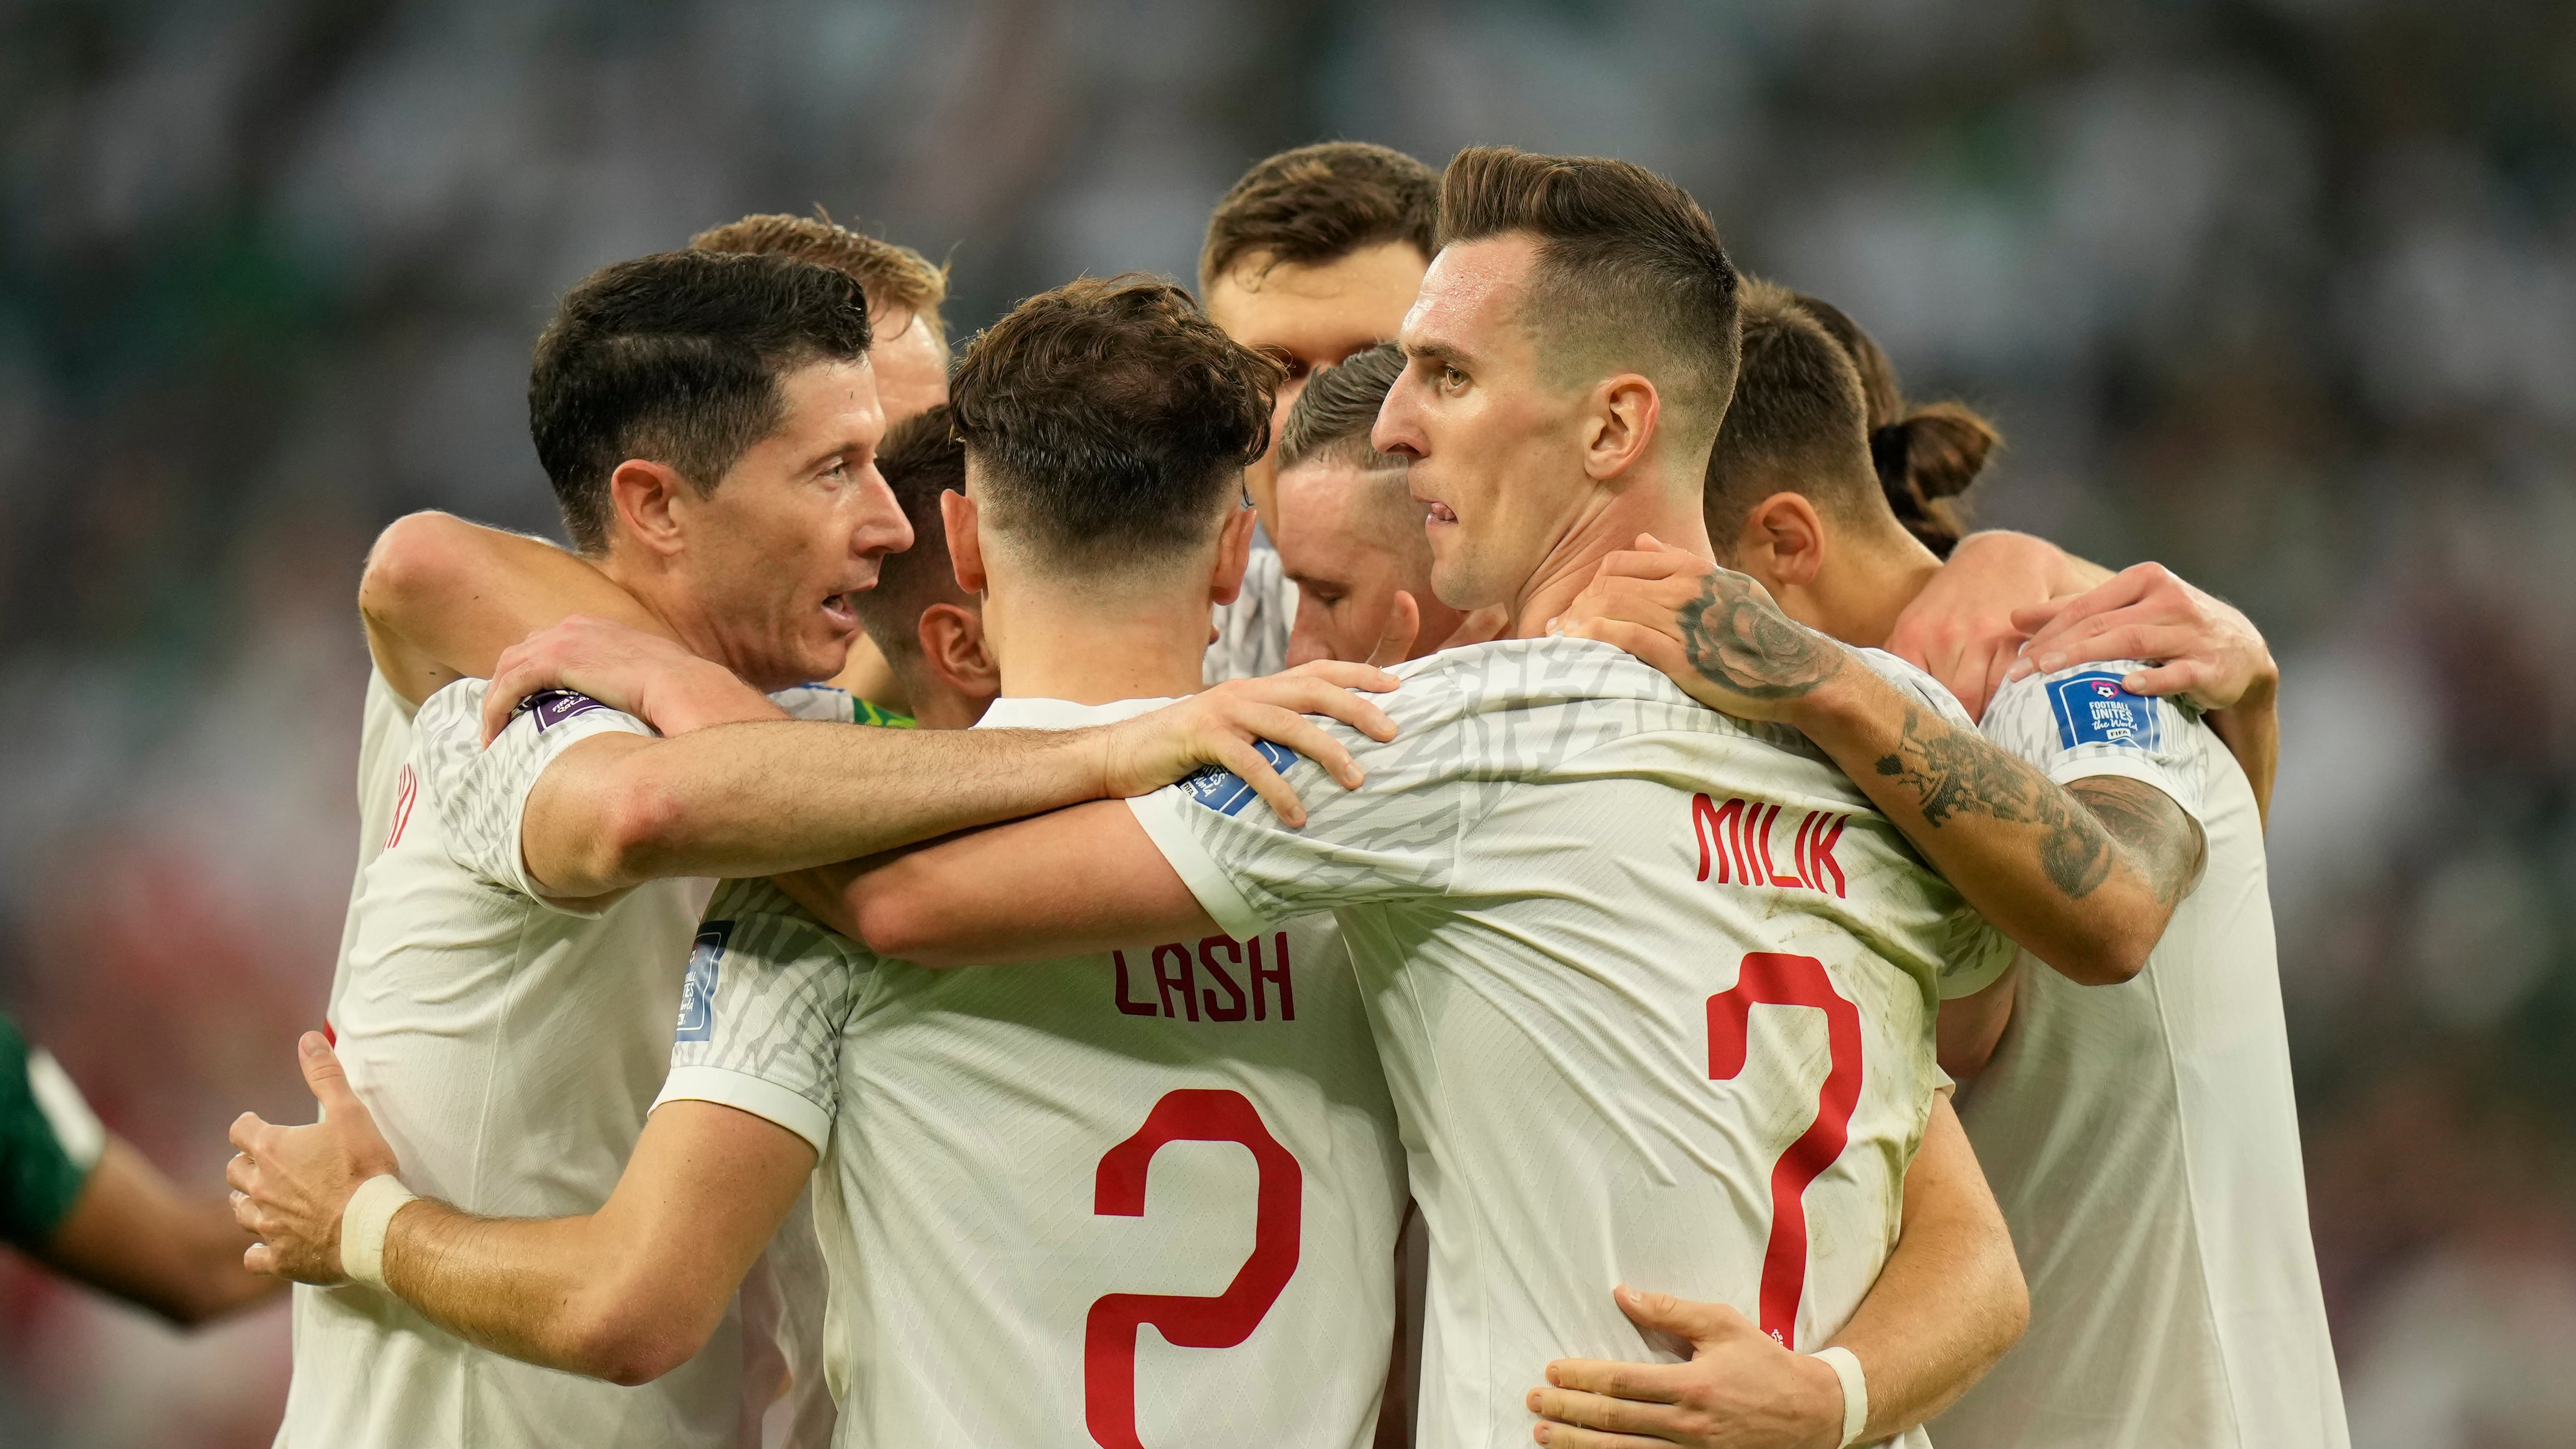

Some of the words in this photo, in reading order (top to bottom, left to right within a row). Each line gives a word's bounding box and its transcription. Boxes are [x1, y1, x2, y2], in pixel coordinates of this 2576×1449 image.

[2089, 701, 2129, 711] FOOTBALL
[2091, 709, 2133, 722] UNITES
[2092, 720, 2110, 730] the
[2110, 719, 2138, 731] World
[1183, 783, 1194, 795] FIFA
[1692, 793, 1852, 899] MILIK
[1706, 952, 1862, 1351] 7
[1084, 1088, 1302, 1449] 2
